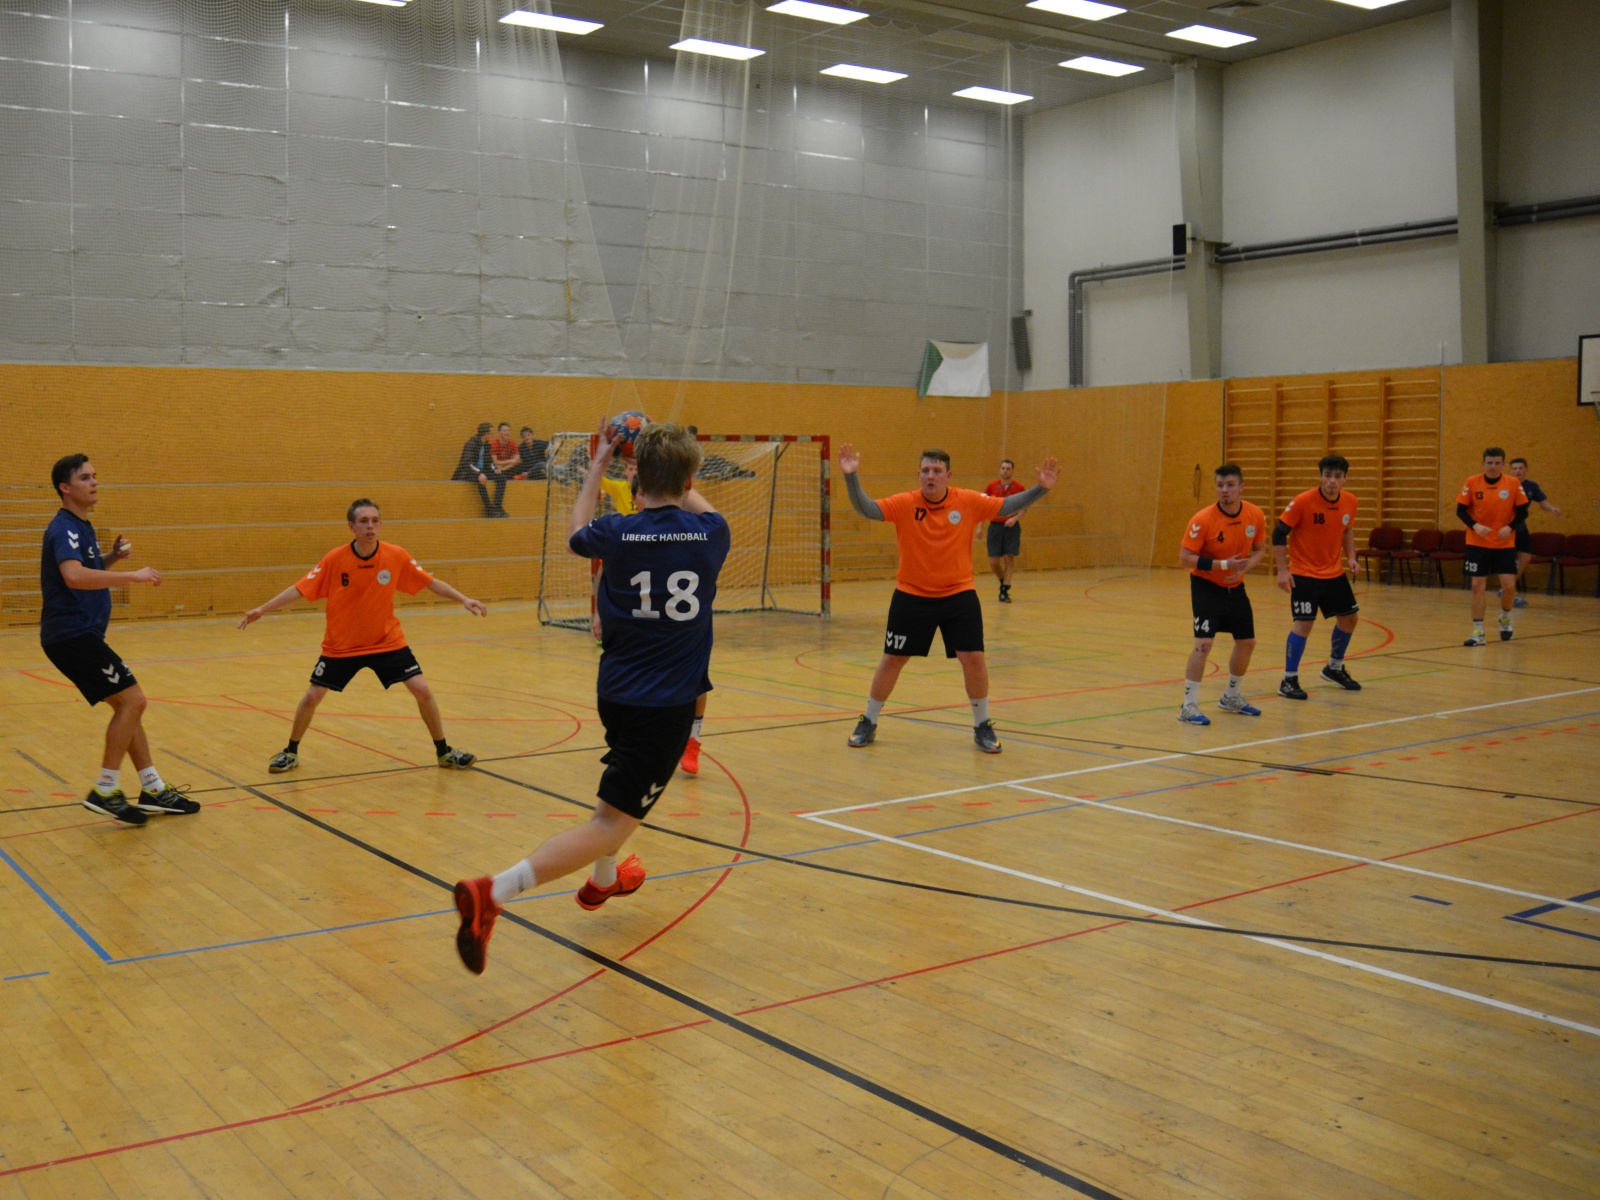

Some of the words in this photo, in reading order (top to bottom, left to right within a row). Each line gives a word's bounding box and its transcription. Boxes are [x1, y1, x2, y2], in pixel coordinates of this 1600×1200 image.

[914, 507, 927, 521] 17
[1313, 512, 1325, 525] 18
[621, 533, 657, 542] LIBEREC
[659, 532, 708, 542] HANDBALL
[1217, 530, 1225, 544] 4
[1469, 563, 1478, 572] 13
[341, 572, 349, 587] 6
[630, 570, 700, 621] 18
[1300, 602, 1312, 614] 18
[1200, 620, 1210, 633] 4
[893, 635, 907, 649] 17
[315, 661, 326, 677] 6
